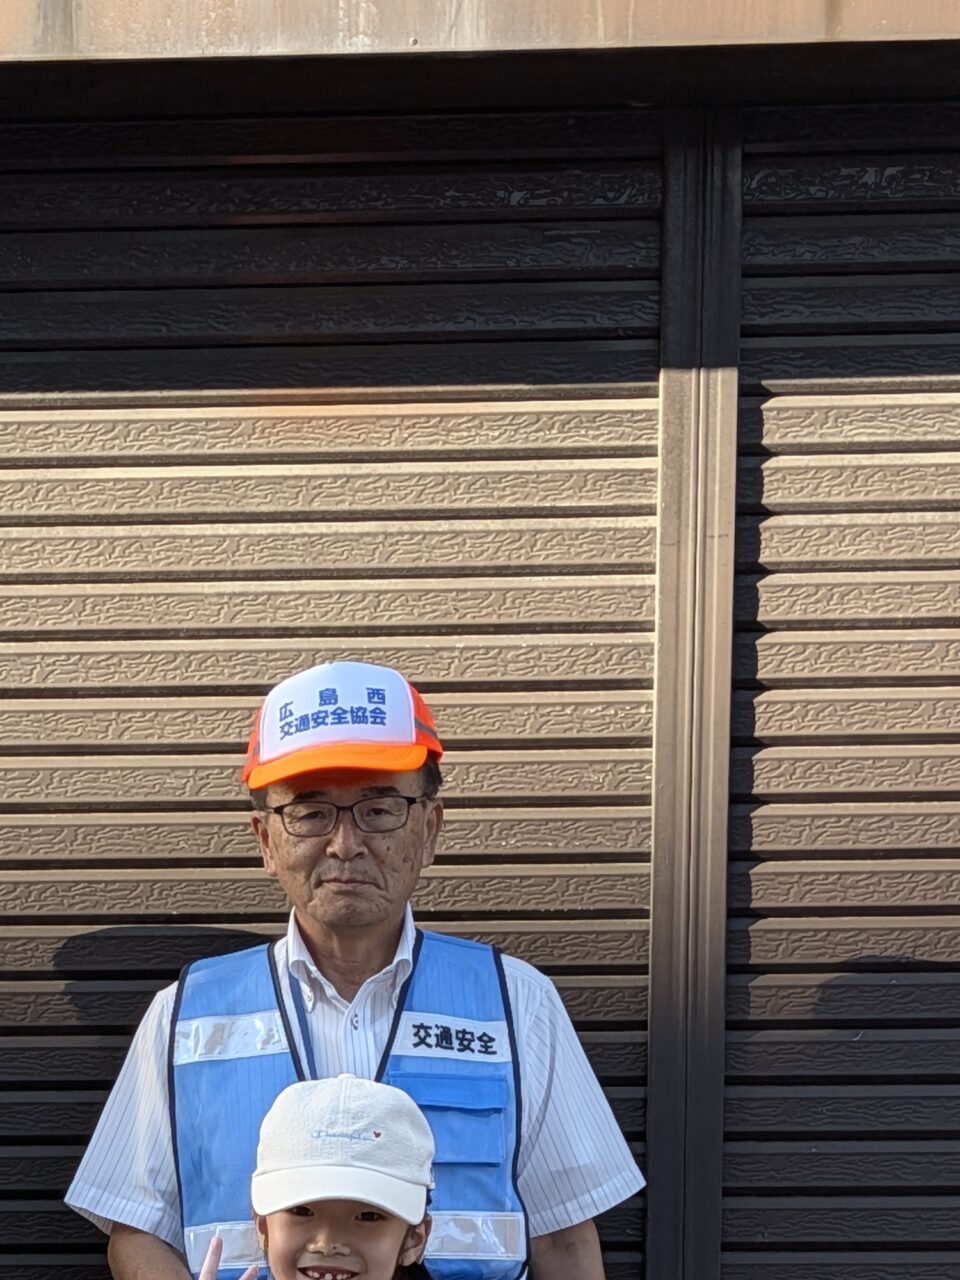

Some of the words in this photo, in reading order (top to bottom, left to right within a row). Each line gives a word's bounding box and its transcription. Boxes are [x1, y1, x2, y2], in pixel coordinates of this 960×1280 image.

[279, 706, 387, 740] 交通安全協会
[411, 1022, 498, 1055] 交通安全
